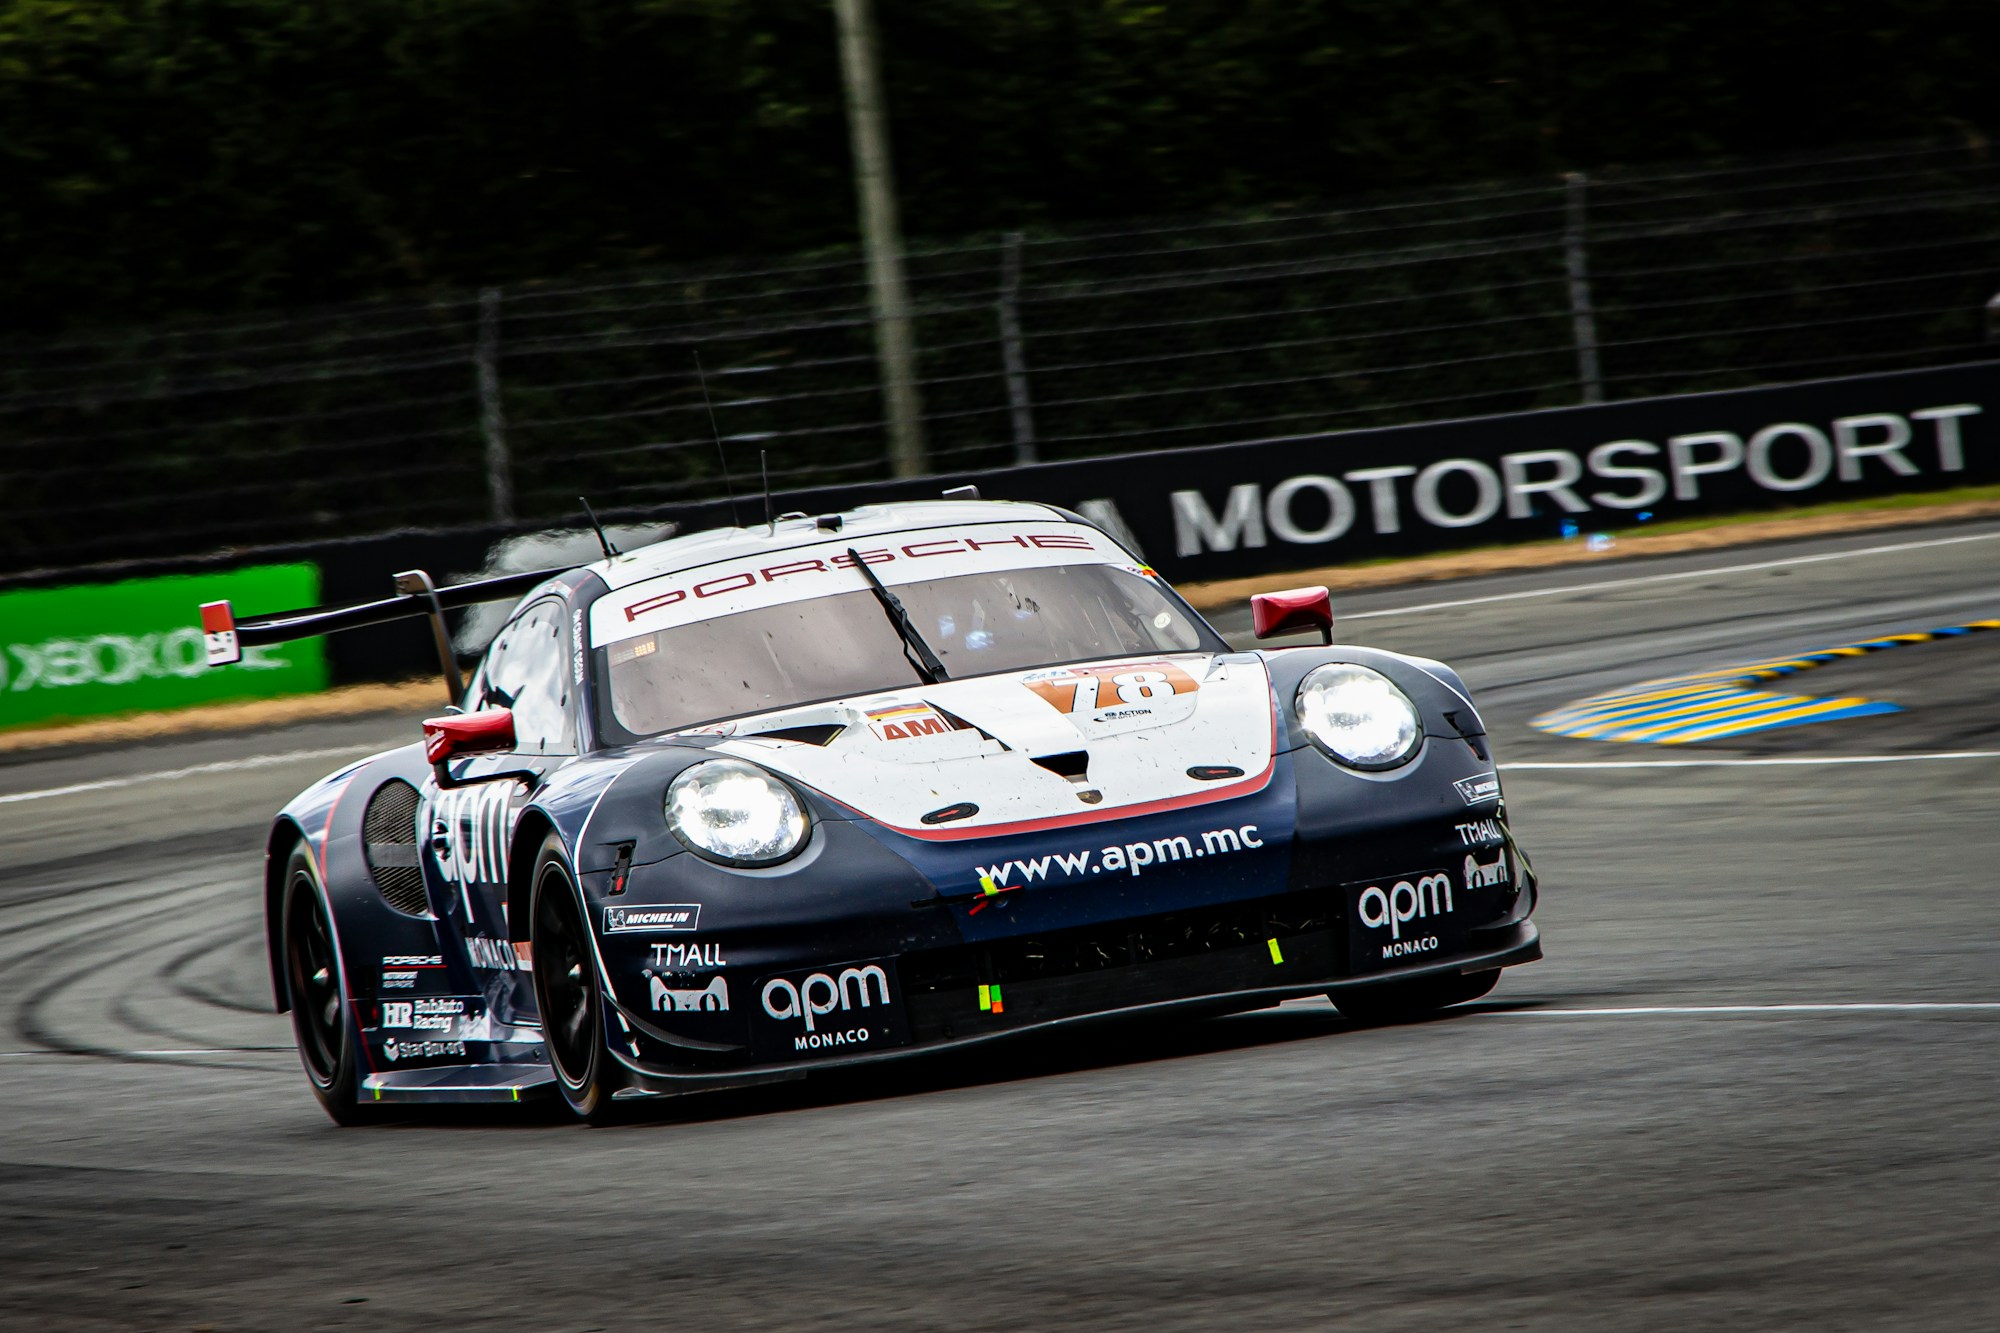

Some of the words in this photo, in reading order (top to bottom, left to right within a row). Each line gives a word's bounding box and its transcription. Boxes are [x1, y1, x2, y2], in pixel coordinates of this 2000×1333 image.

[1170, 403, 1983, 558] MOTORSPORT
[624, 534, 1095, 622] PORSCHE
[1051, 671, 1176, 713] 78
[883, 718, 945, 740] AM
[1454, 819, 1501, 846] TMALL
[975, 825, 1264, 877] www.apm.mc
[626, 912, 690, 925] MICHELIN
[1358, 873, 1453, 940] apm
[650, 943, 727, 967] TMALL
[1382, 936, 1439, 959] MONACO
[761, 964, 891, 1032] apm
[794, 1027, 870, 1051] MONACO
